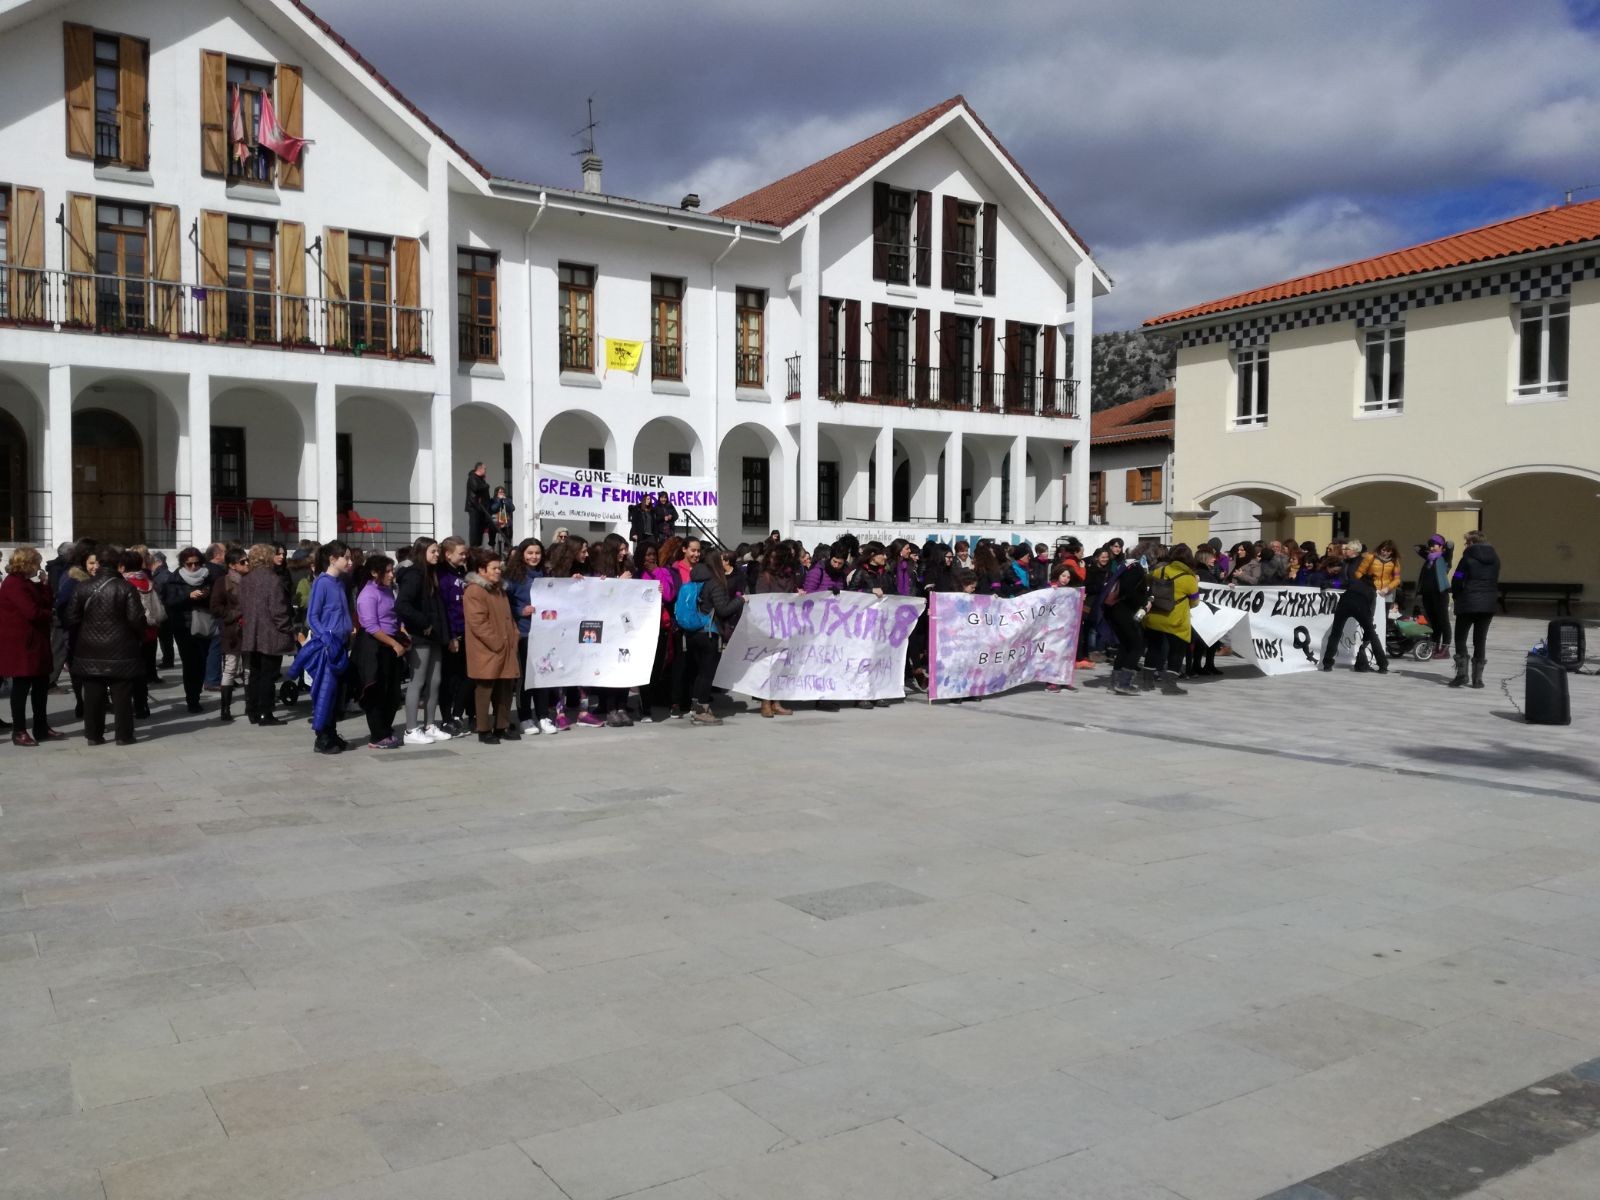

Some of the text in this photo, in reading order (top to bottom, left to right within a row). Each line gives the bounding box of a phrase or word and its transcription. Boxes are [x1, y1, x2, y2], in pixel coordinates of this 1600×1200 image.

[575, 470, 664, 488] GUNE HAUEK
[539, 478, 718, 507] GREBA FEMINSAREKIN
